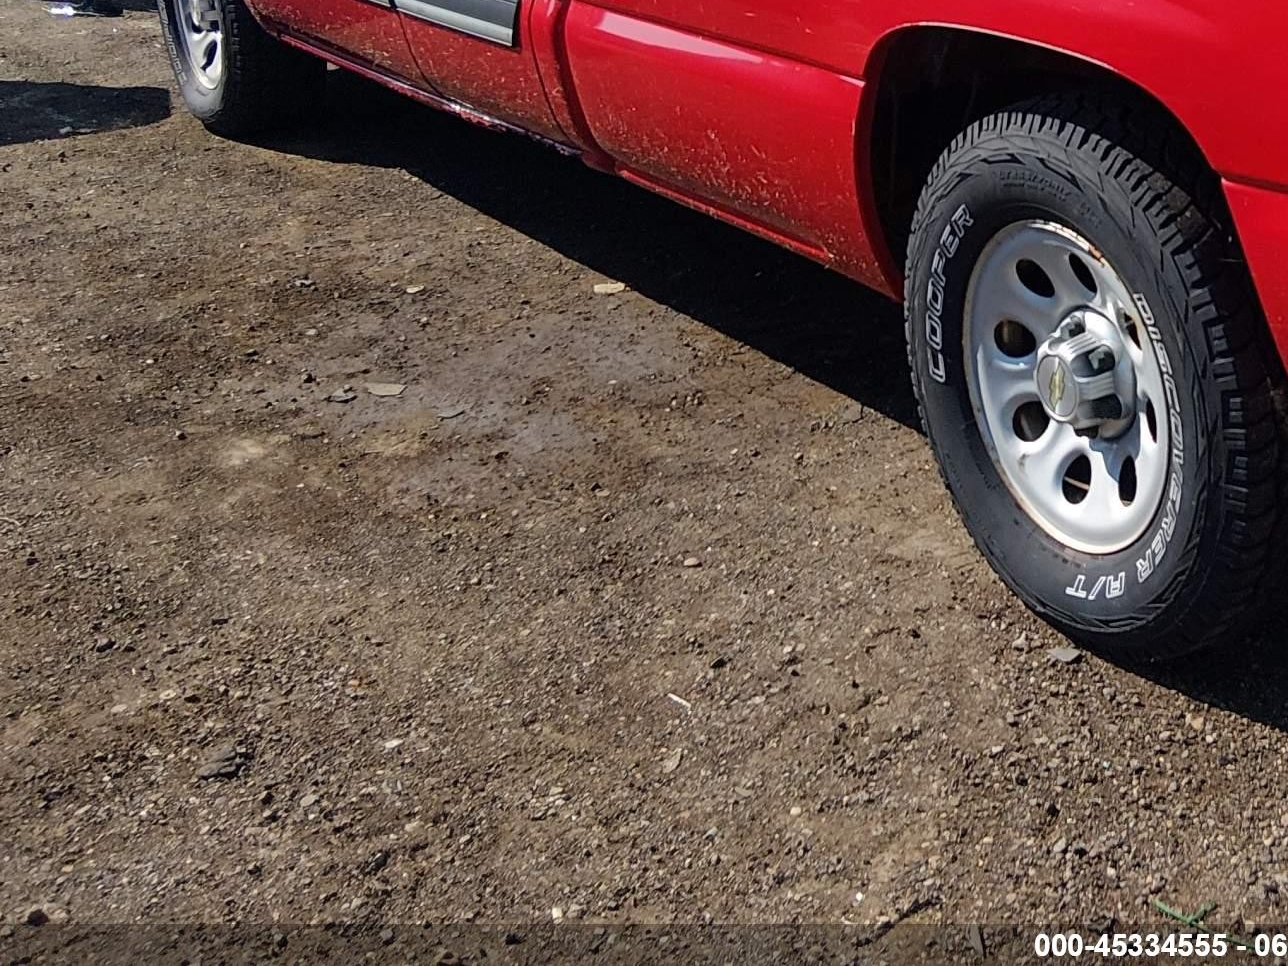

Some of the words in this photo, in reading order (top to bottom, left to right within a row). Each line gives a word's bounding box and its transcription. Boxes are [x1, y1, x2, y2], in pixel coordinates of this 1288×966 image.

[926, 204, 974, 383] COOPER
[1133, 293, 1183, 584] DISCOVERER
[1065, 571, 1126, 601] A/T
